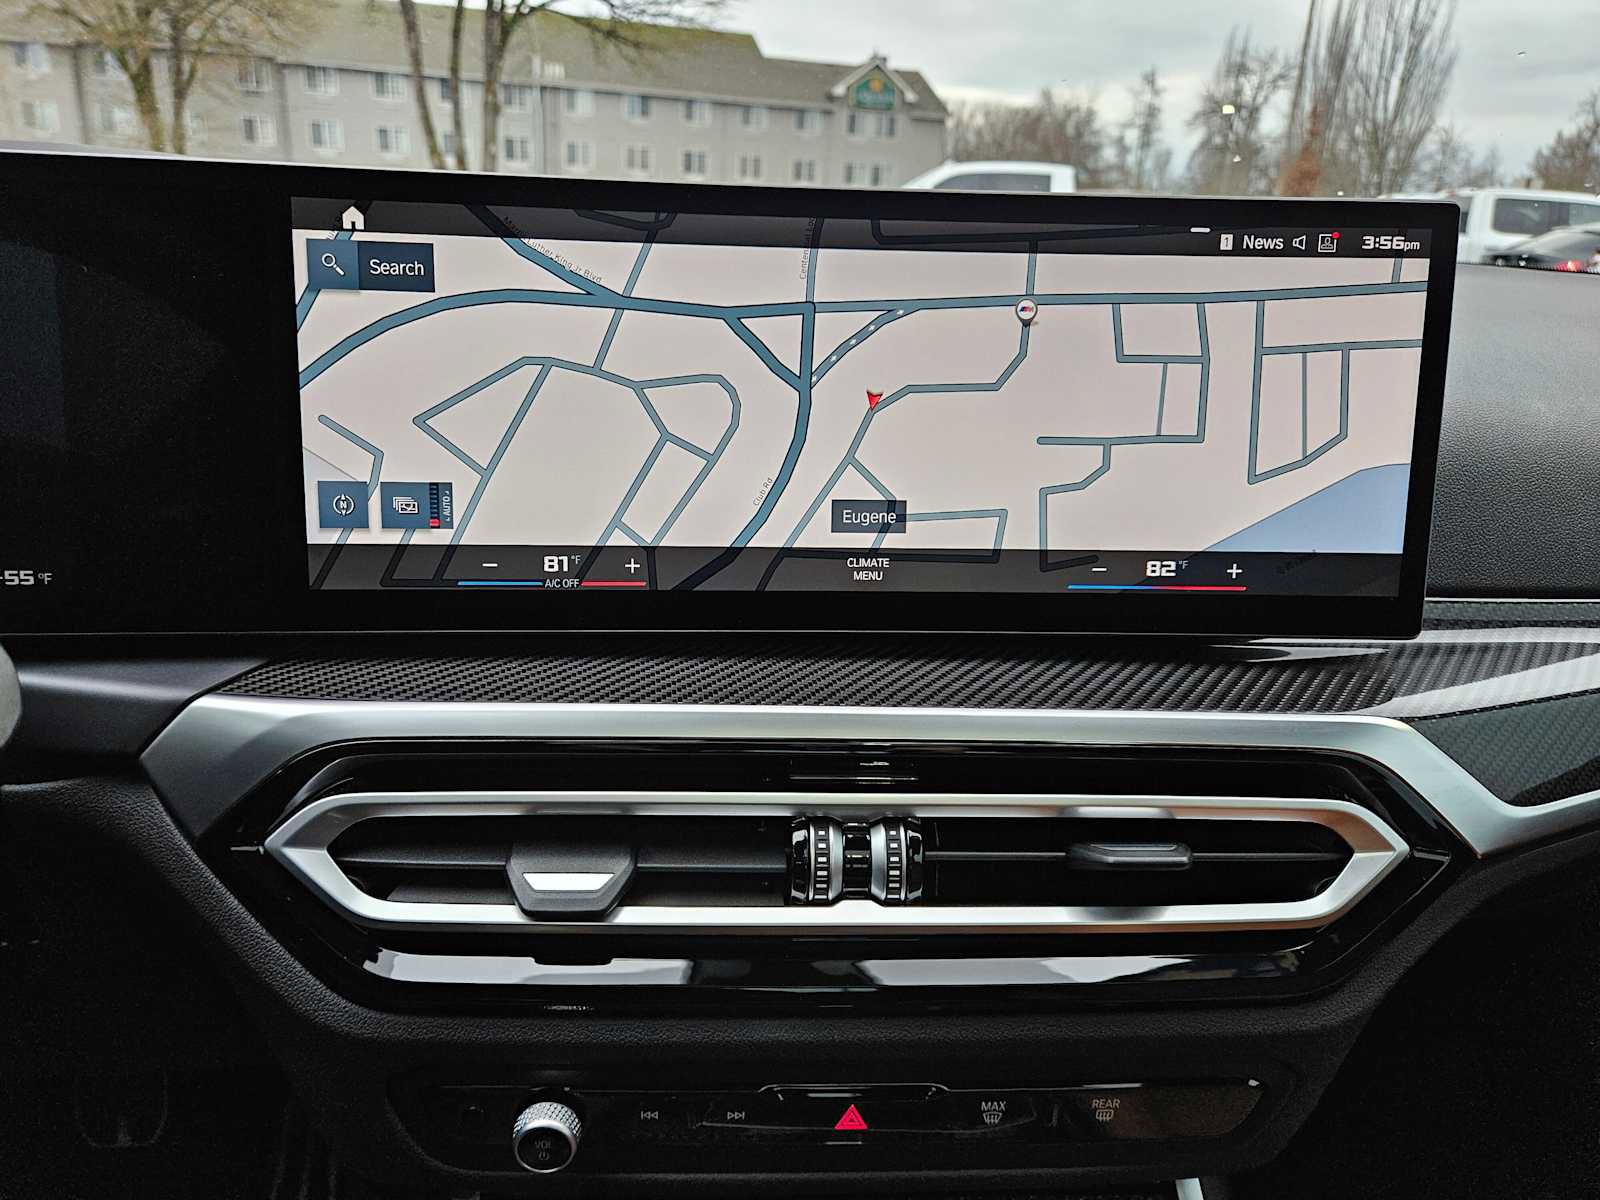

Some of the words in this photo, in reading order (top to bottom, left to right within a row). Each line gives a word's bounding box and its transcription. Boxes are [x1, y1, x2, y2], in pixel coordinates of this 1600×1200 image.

[1243, 234, 1284, 250] News
[369, 258, 425, 276] Search
[555, 254, 575, 270] King
[584, 269, 603, 283] Blvd
[753, 489, 767, 506] Club
[762, 477, 773, 489] Rd
[442, 495, 452, 516] AUTO
[842, 509, 897, 526] Eugene
[847, 558, 890, 568] CLIMATE
[544, 579, 561, 588] A/C
[562, 579, 580, 588] OFF
[853, 571, 883, 581] MENU
[981, 1101, 1007, 1112] MAX
[1092, 1098, 1121, 1110] REAR
